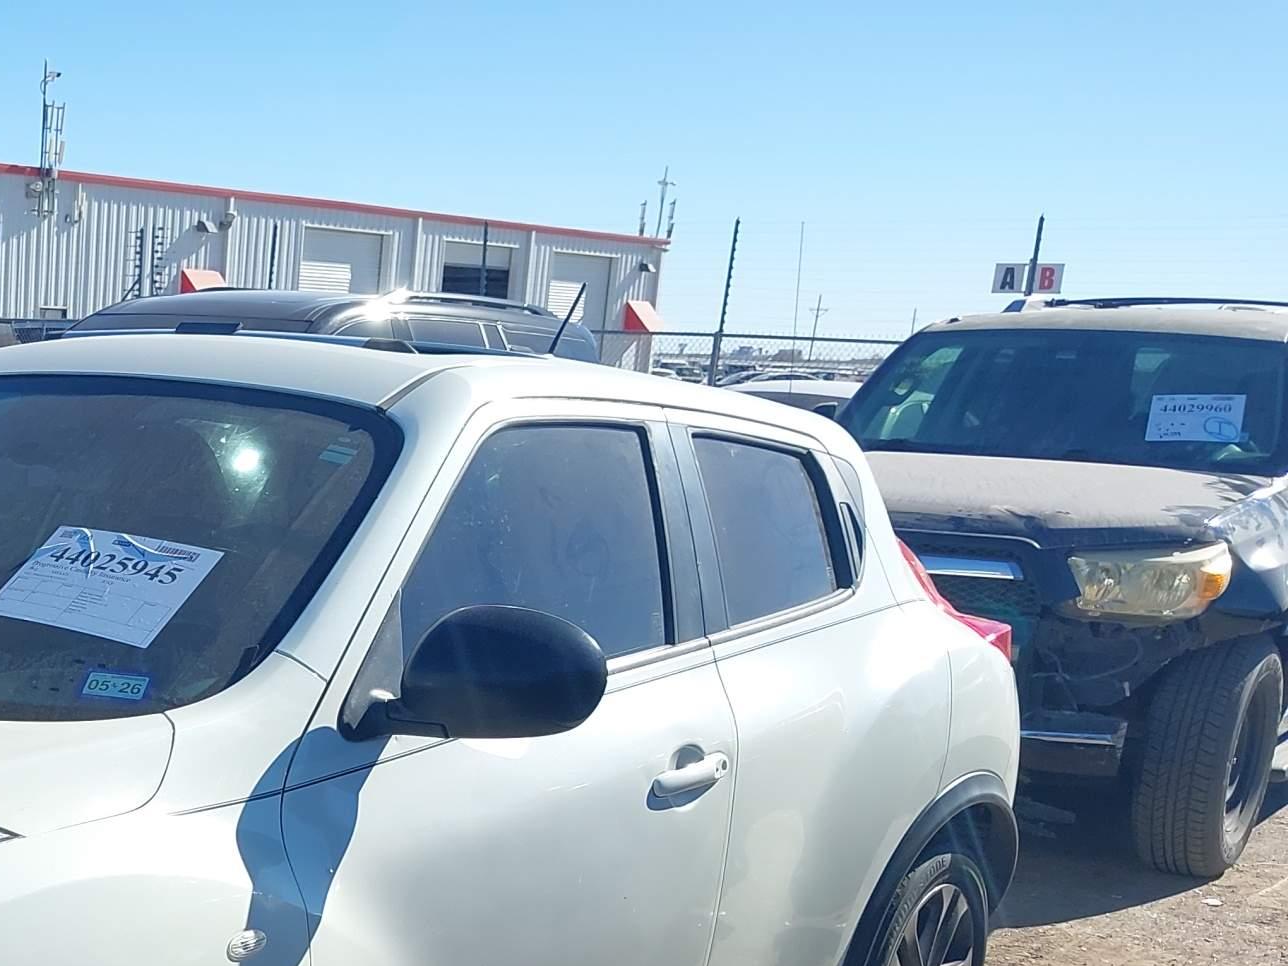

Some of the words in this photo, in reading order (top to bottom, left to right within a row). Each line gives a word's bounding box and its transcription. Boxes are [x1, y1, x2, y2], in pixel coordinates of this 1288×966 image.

[999, 266, 1015, 290] A
[1038, 266, 1056, 290] B
[50, 546, 185, 585] 44025945
[88, 679, 112, 691] 05
[119, 682, 142, 695] 26
